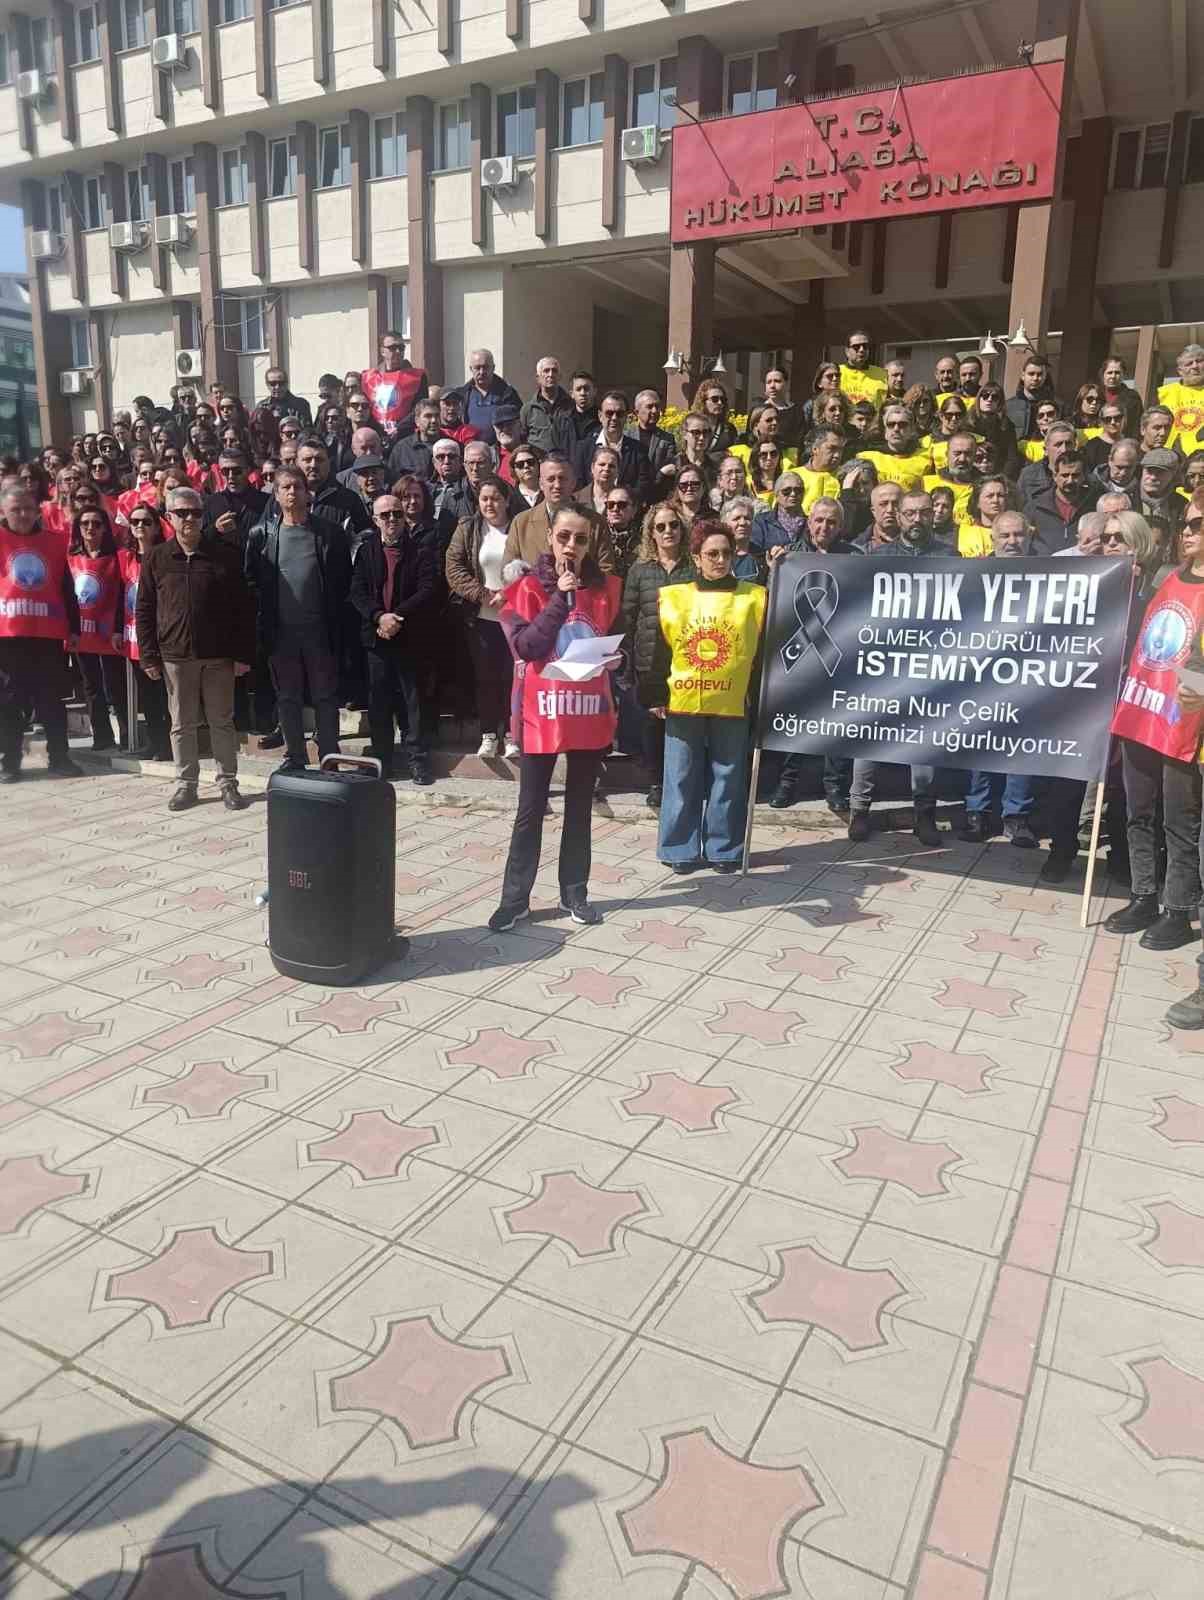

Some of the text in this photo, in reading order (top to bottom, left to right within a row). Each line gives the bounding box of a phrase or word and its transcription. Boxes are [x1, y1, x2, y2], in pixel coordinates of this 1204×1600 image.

[685, 160, 1038, 228] HÜKÜMET KONAĞI
[871, 572, 1100, 625] ARTIK YETER!
[537, 690, 600, 720] Eğitim
[832, 690, 1019, 725] Fatma Nur Çelik
[773, 713, 1083, 757] öğretmenimizi uğurluyoruz.
